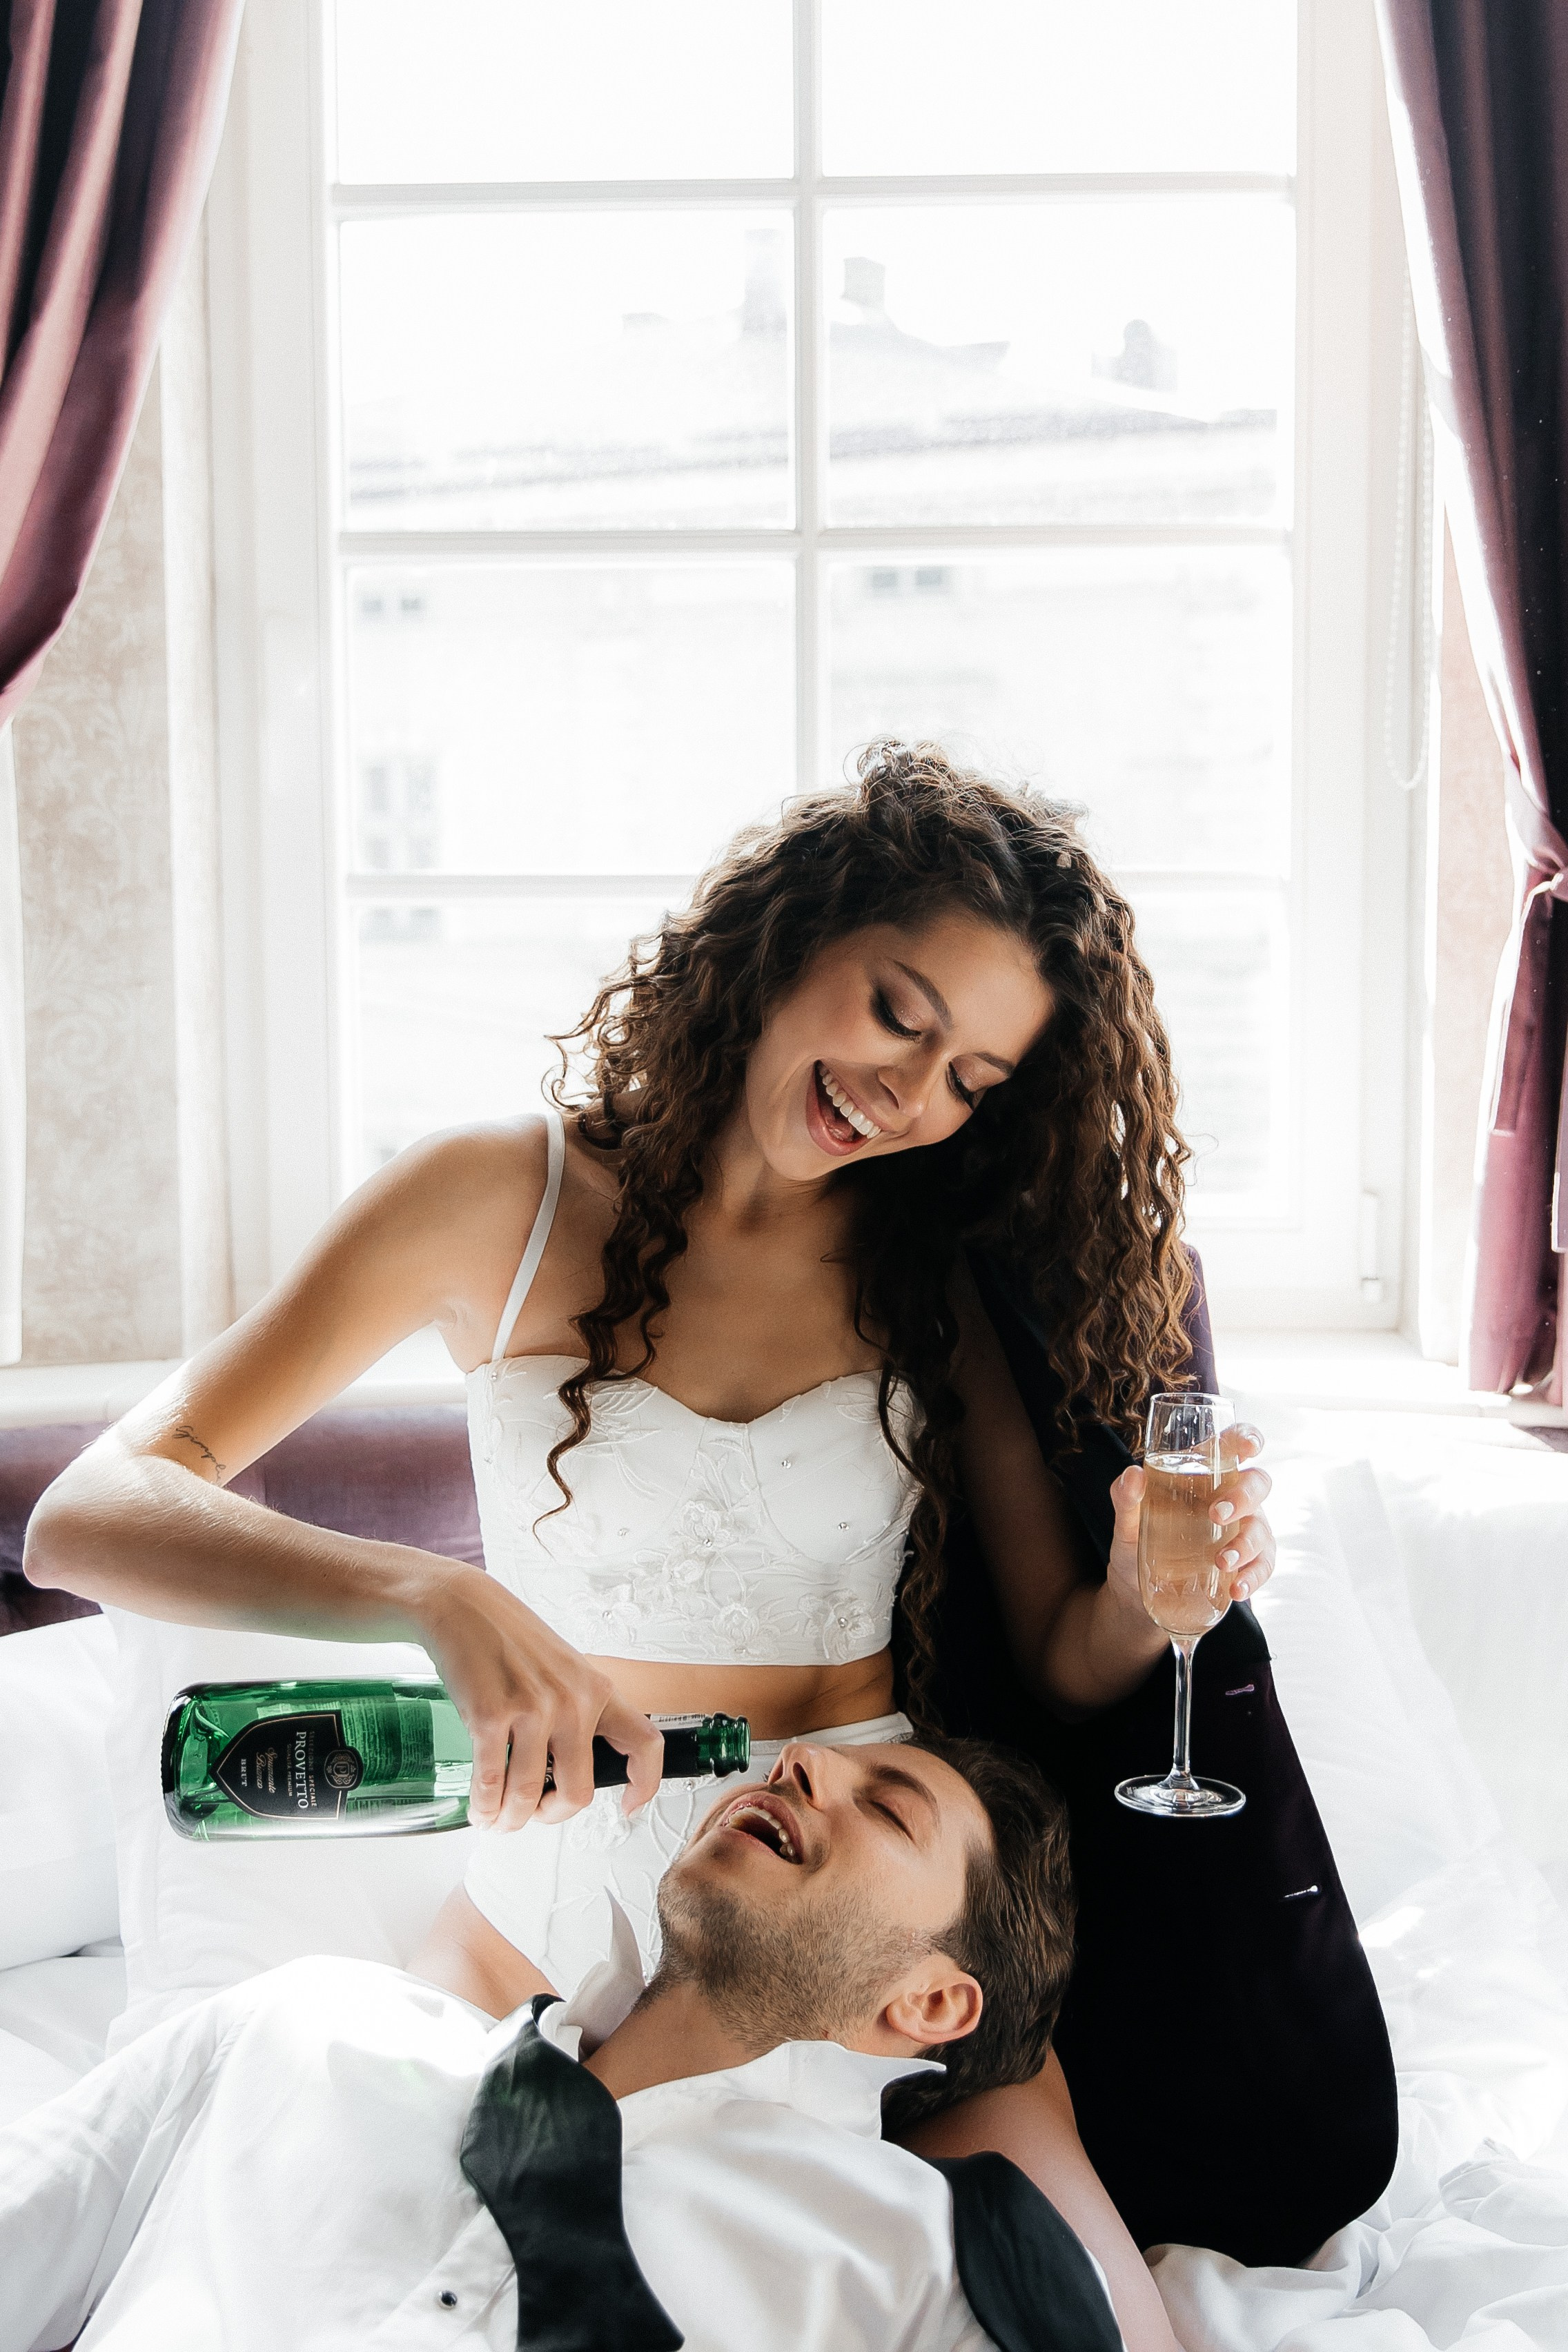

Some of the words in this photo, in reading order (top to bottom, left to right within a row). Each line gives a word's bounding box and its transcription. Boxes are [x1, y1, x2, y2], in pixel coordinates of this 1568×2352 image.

[256, 1752, 266, 1789] Bianco
[267, 1747, 277, 1794] Spumante
[295, 1731, 309, 1809] PROVETTO
[308, 1774, 317, 1807] SPECIALE
